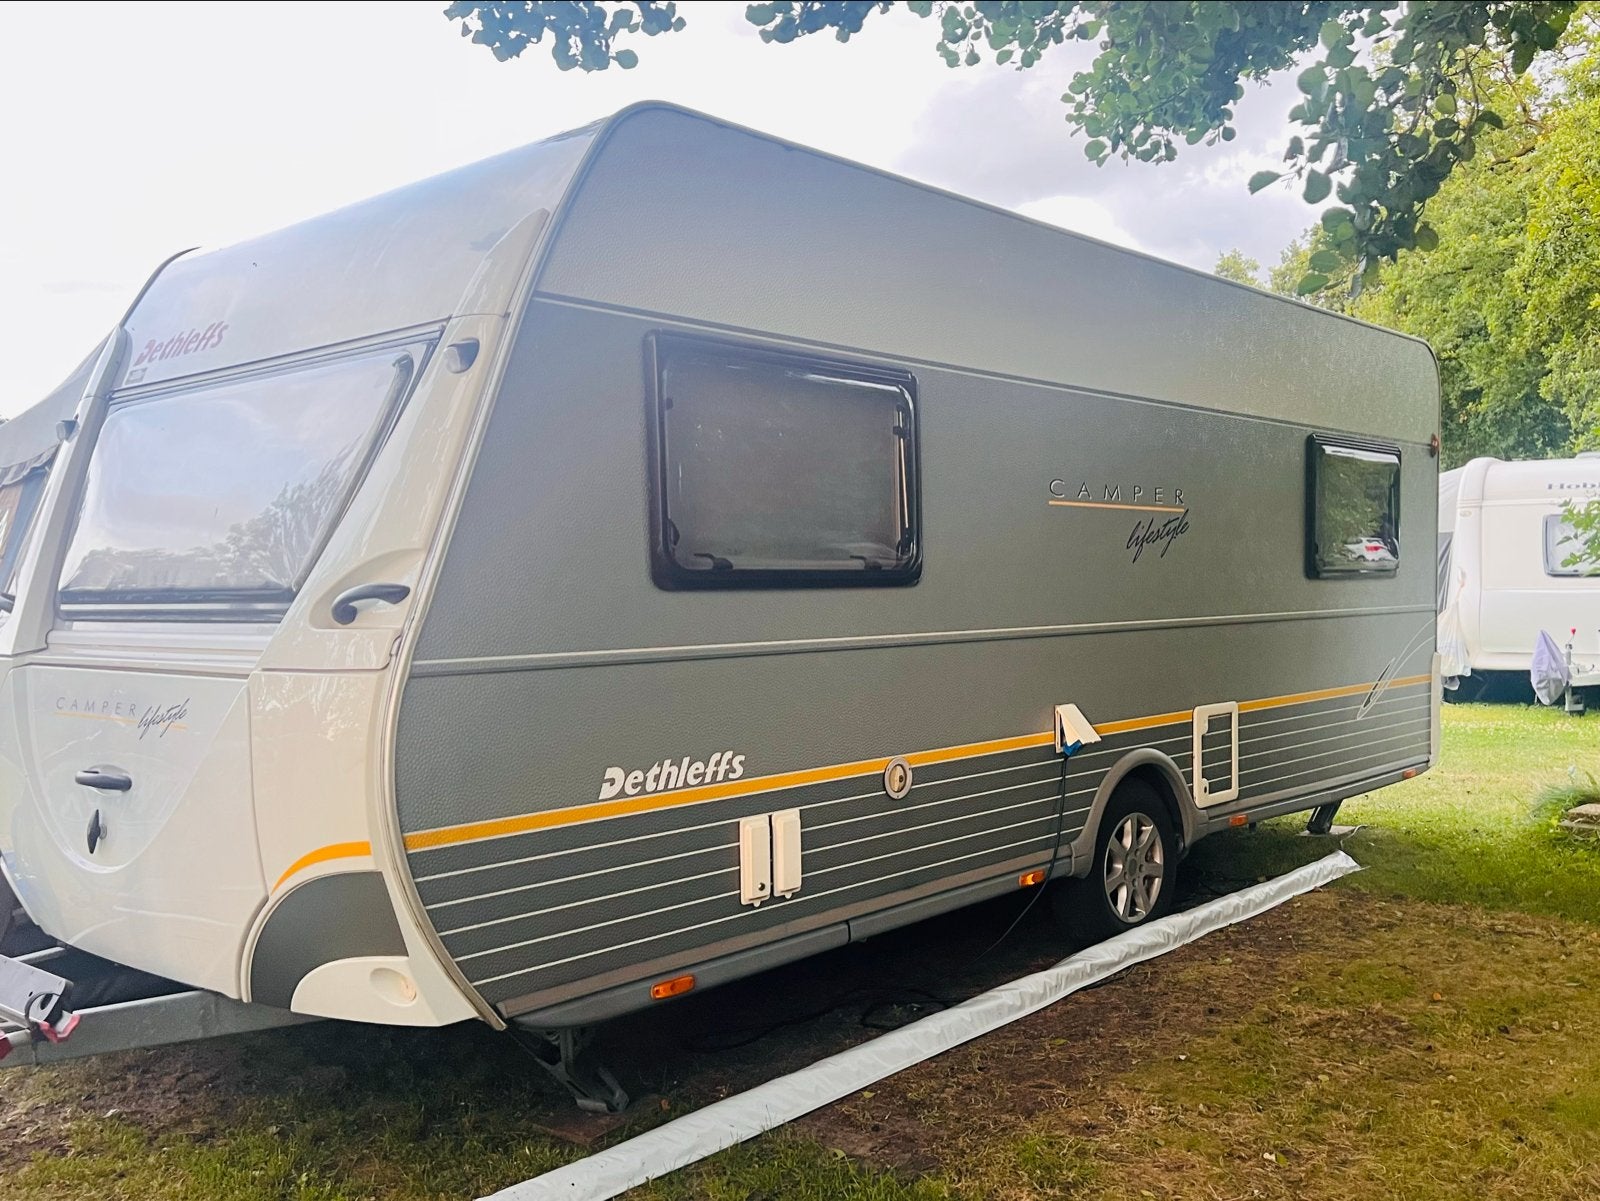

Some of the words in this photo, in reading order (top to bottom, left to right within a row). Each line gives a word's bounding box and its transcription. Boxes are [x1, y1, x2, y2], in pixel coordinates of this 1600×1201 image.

[133, 320, 230, 367] Dethleffs
[1049, 478, 1185, 505] CAMPER
[1548, 482, 1600, 490] Hob
[1126, 508, 1190, 564] lifestyle
[56, 696, 137, 716] CAMPER
[137, 697, 190, 740] lifestyle
[598, 750, 746, 800] Dethleffs
